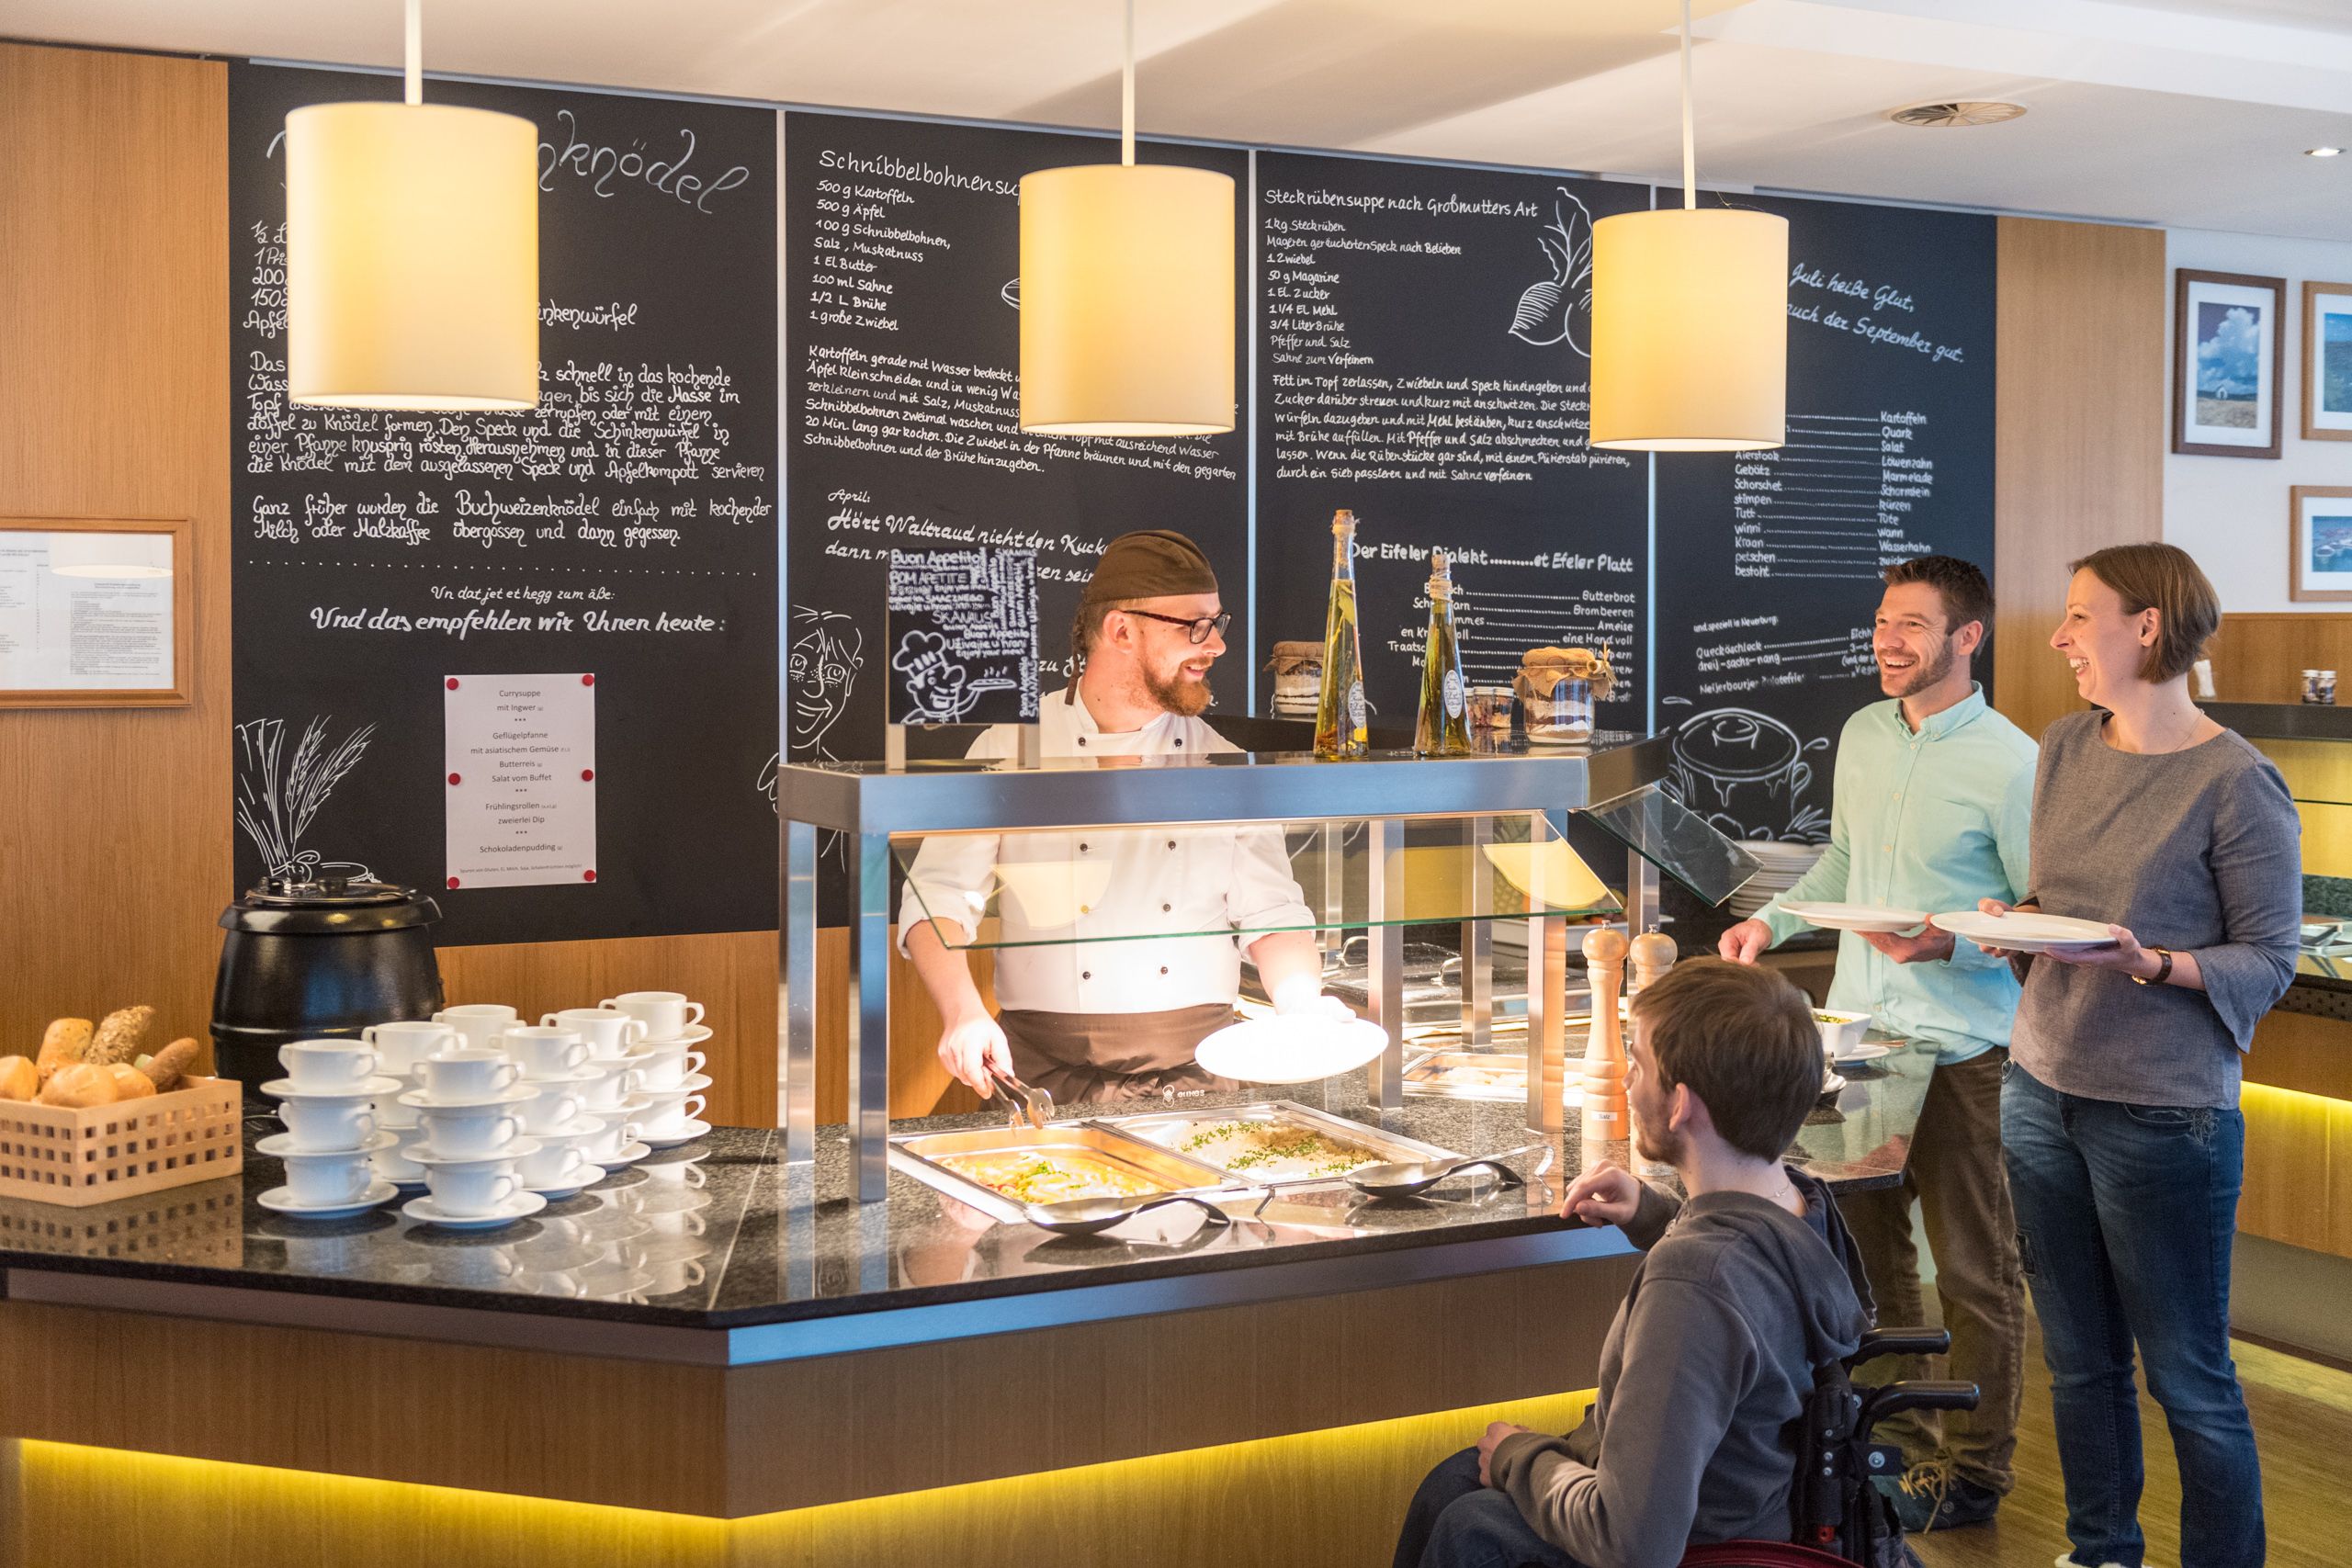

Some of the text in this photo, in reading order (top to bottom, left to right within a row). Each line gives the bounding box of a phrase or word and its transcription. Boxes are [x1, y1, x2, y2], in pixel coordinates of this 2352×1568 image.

[819, 150, 1020, 205] Schnibbelbohnensu
[817, 180, 914, 205] 500 g Kartoffeln
[1264, 189, 1538, 218] Steckrübensuppe nach Großmutters Art
[816, 220, 951, 249] 100 g Schnibbelbohnen,
[1291, 220, 1345, 231] Steckrüben
[1267, 235, 1461, 255] Mageren geräucherten Speck nach Belieben
[813, 274, 893, 294] 100 ml Sahne
[1268, 270, 1340, 286] 50 g Magarine
[1789, 263, 1914, 312] Juli heiße Glut,
[810, 291, 887, 311] 1/2 L Brühe
[809, 310, 899, 331] 1 große Zwiebel
[1824, 311, 1849, 330] der
[1853, 317, 1931, 353] September
[1933, 345, 1964, 363] gut.
[809, 345, 1013, 382] Kartoffeln gerade mit Wasser bedeckt
[1272, 353, 1374, 367] Sahne zum Verfeinern
[556, 360, 730, 389] schnell in das kochende
[1881, 411, 1928, 424] Kartoffeln
[1882, 427, 1913, 440] Quark
[803, 434, 1045, 473] Schnibbelbohnen und der Brühe hinzugeben.
[1882, 441, 1904, 453] Salat
[248, 453, 764, 485] die Knödel mit dem ausgelassenen Speck und Apfelkompott servieren
[1882, 456, 1933, 469] Löwenzahn
[1277, 468, 1532, 483] durch ein Sieb passieren und mit Sahne verfeinern
[1883, 472, 1933, 484] Marmelade
[828, 488, 870, 505] April:
[253, 490, 772, 525] Ganz früher wurden die Buchweizenknödel einfach mit kochender
[254, 517, 680, 548] Milch oder Malzkaffee übergossen und dann gegessen.
[828, 507, 1054, 551] Hört Waltraud nicht den
[825, 540, 871, 560] dann
[891, 548, 924, 565] Buon
[1879, 539, 1930, 554] Wasserhahn
[1381, 543, 1429, 561] Eifeler
[1598, 553, 1634, 572] Platt
[458, 585, 481, 601] dat
[481, 587, 503, 605] jet
[506, 588, 522, 600] et
[523, 586, 552, 604] hegg
[557, 590, 583, 601] zum
[1582, 590, 1635, 603] Butterbrot
[1573, 604, 1634, 617] Brombeeren
[368, 608, 412, 633] das
[415, 607, 532, 640] empfehlen
[538, 612, 573, 632] wir
[1598, 621, 1634, 632] Ameise
[1563, 633, 1633, 645] eine Hand voll
[492, 731, 548, 739] Geflügelpfanne
[485, 802, 540, 811] Frühlingsrollen
[480, 843, 556, 853] Schokoladenpudding
